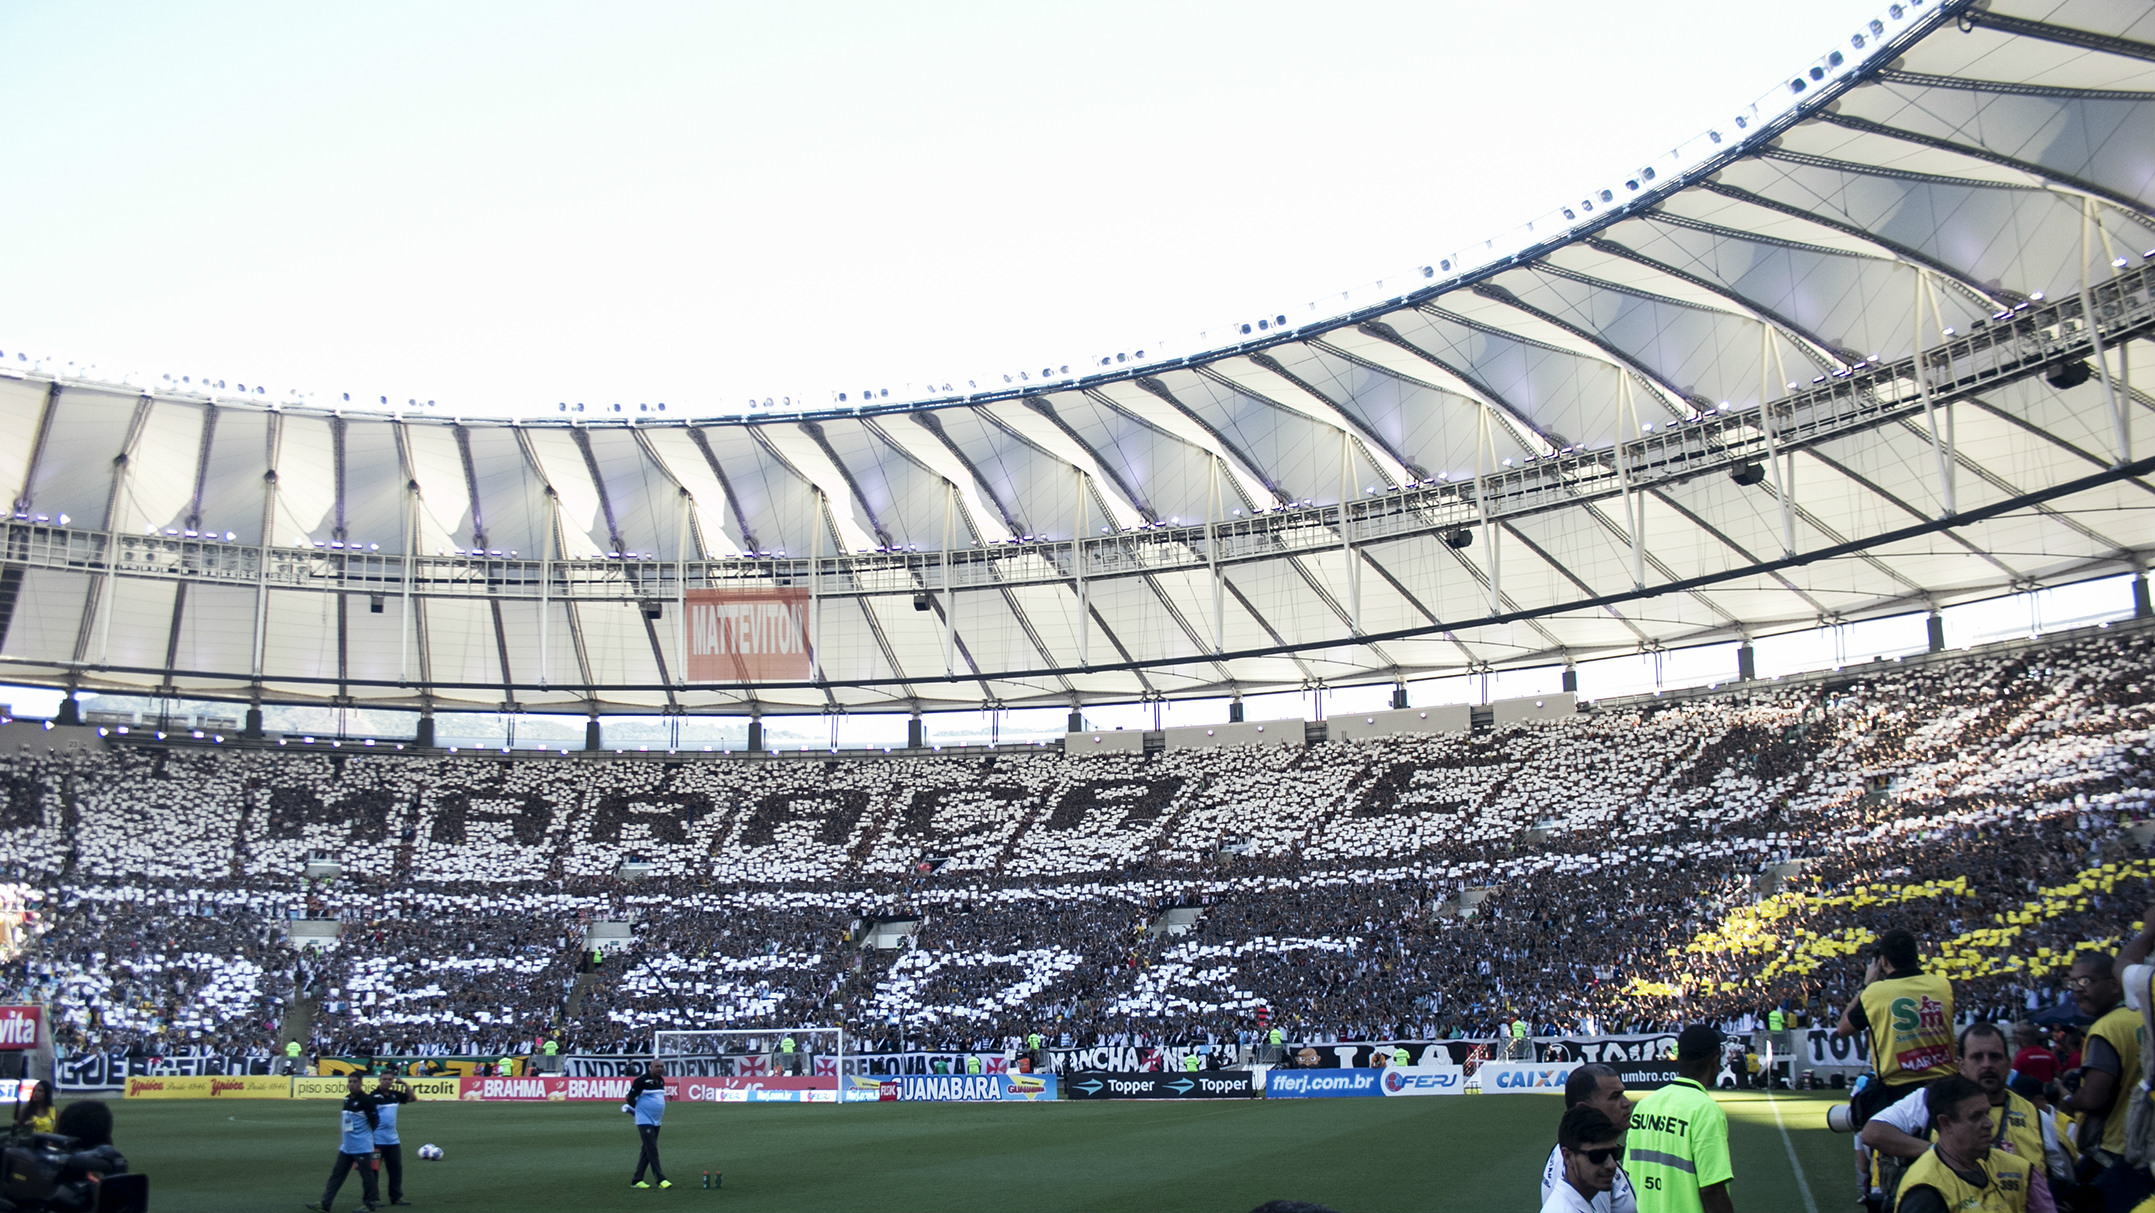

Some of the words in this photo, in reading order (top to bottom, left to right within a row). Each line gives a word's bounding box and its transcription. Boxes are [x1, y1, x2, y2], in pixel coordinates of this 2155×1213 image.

[573, 1056, 734, 1077] INDEPNDENTE
[1107, 1079, 1155, 1094] Topper
[1199, 1078, 1248, 1094] Topper
[1273, 1074, 1374, 1093] fferj.com.br
[1402, 1073, 1457, 1088] FERJ
[1496, 1070, 1568, 1088] CAIXA
[1621, 1071, 1679, 1083] umbro.co
[130, 1078, 164, 1097] Ypióca
[211, 1078, 244, 1097] Ypióca
[298, 1081, 322, 1095] piso
[484, 1079, 546, 1098] BRAHMA
[568, 1079, 632, 1098] BRAHMA
[890, 1076, 1001, 1100] GUANABARA
[1630, 1112, 1689, 1138] SUNSET
[1644, 1176, 1663, 1191] 50
